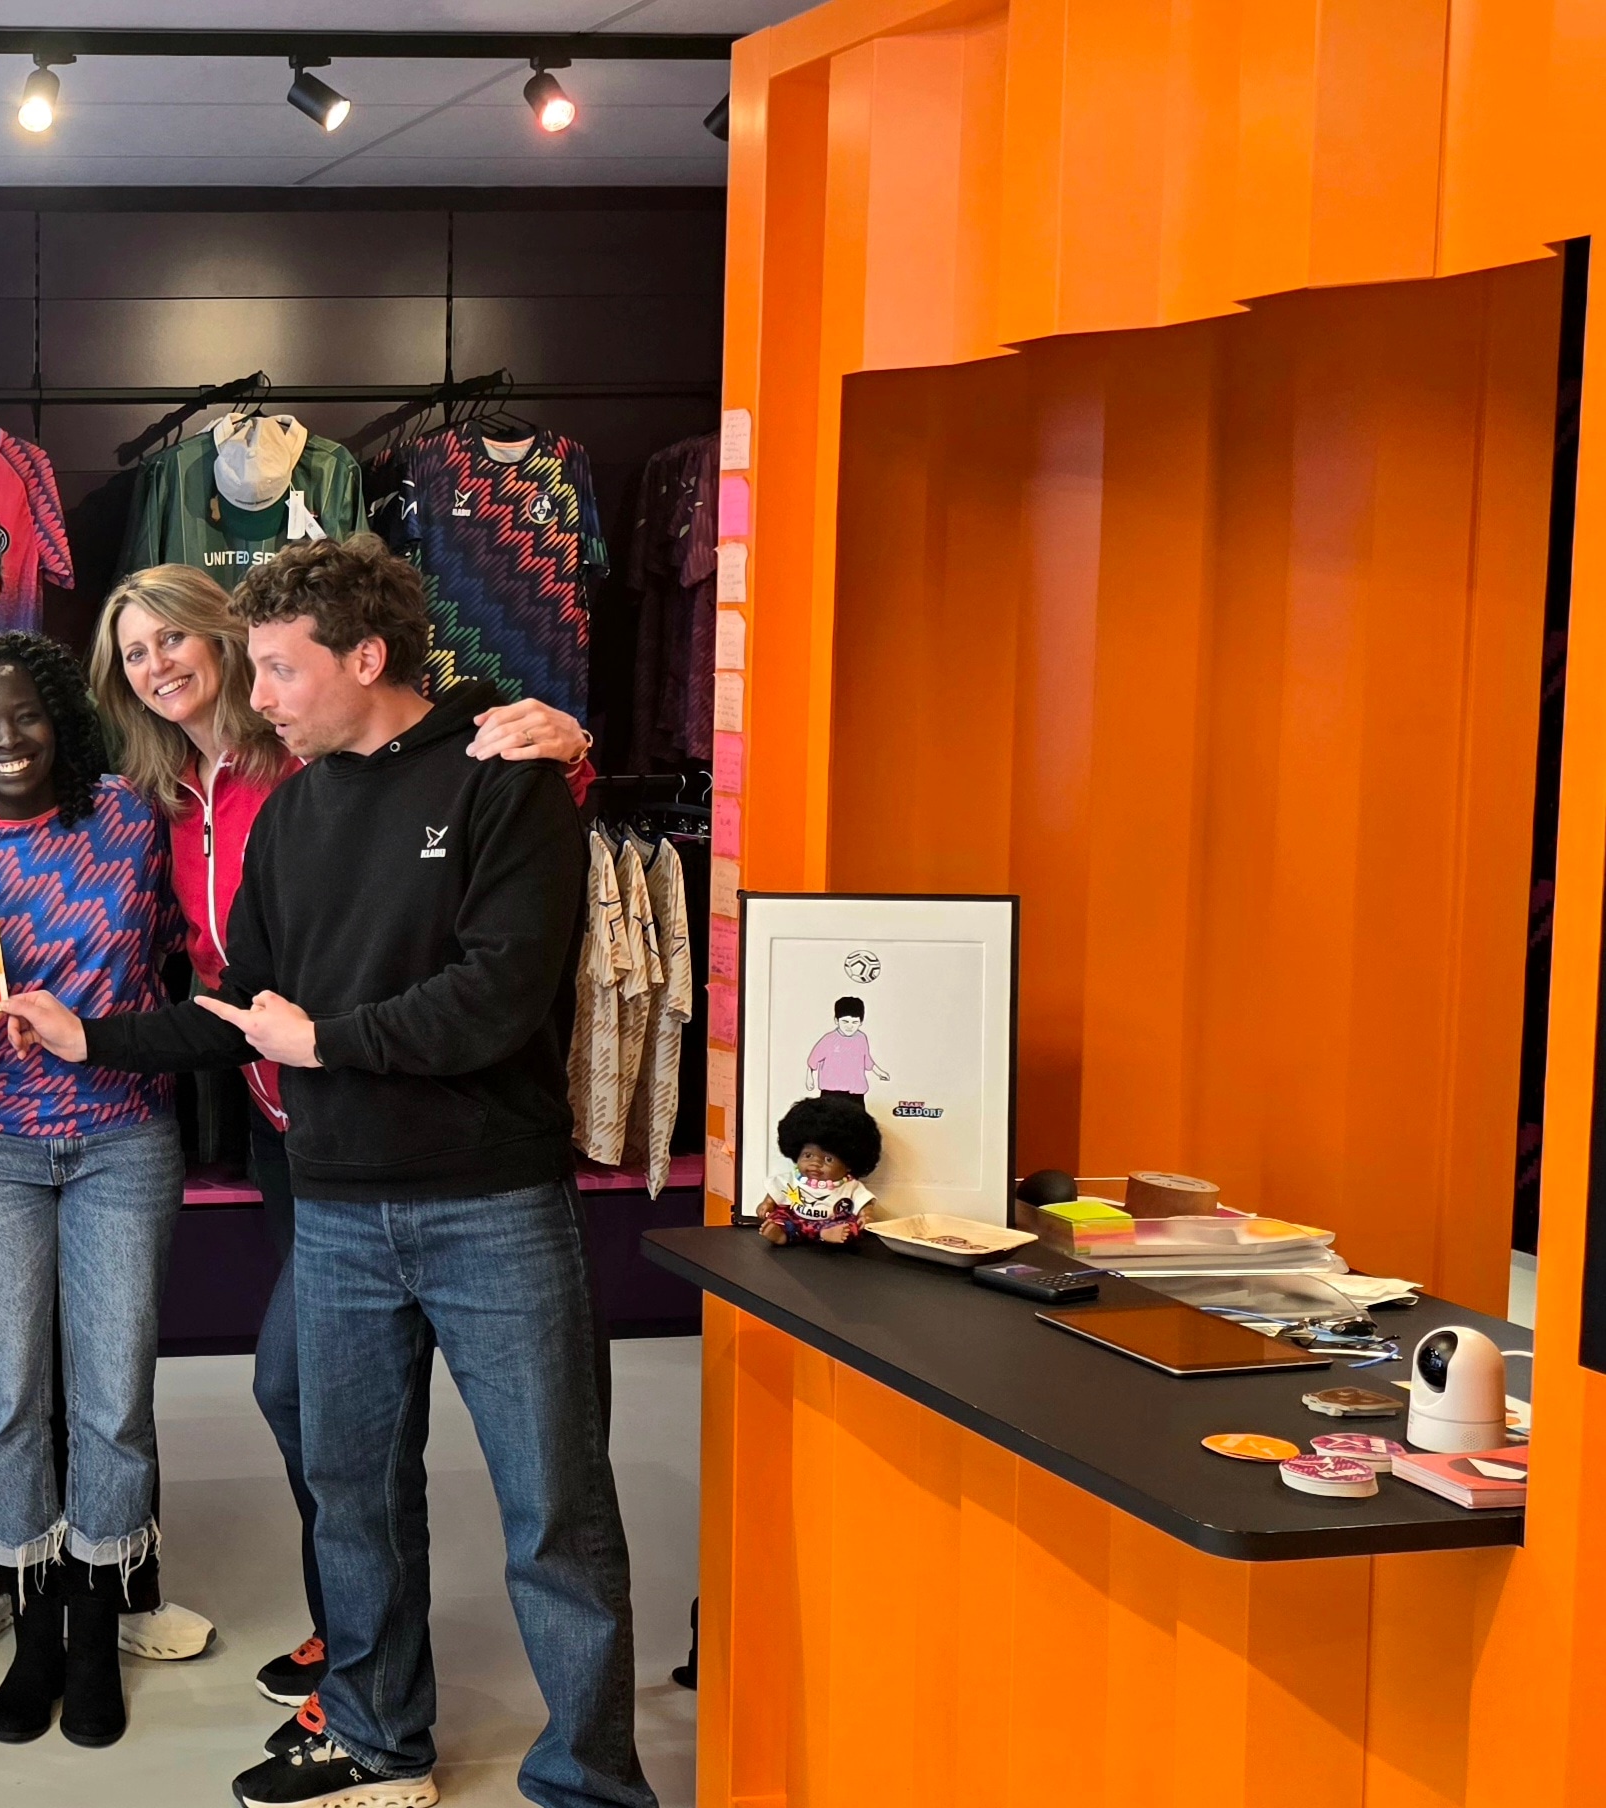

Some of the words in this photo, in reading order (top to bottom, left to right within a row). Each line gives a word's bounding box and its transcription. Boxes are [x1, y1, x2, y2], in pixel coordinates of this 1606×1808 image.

[203, 550, 250, 567] UNITED
[895, 1106, 943, 1117] SEEDORF
[796, 1205, 828, 1219] KLABU
